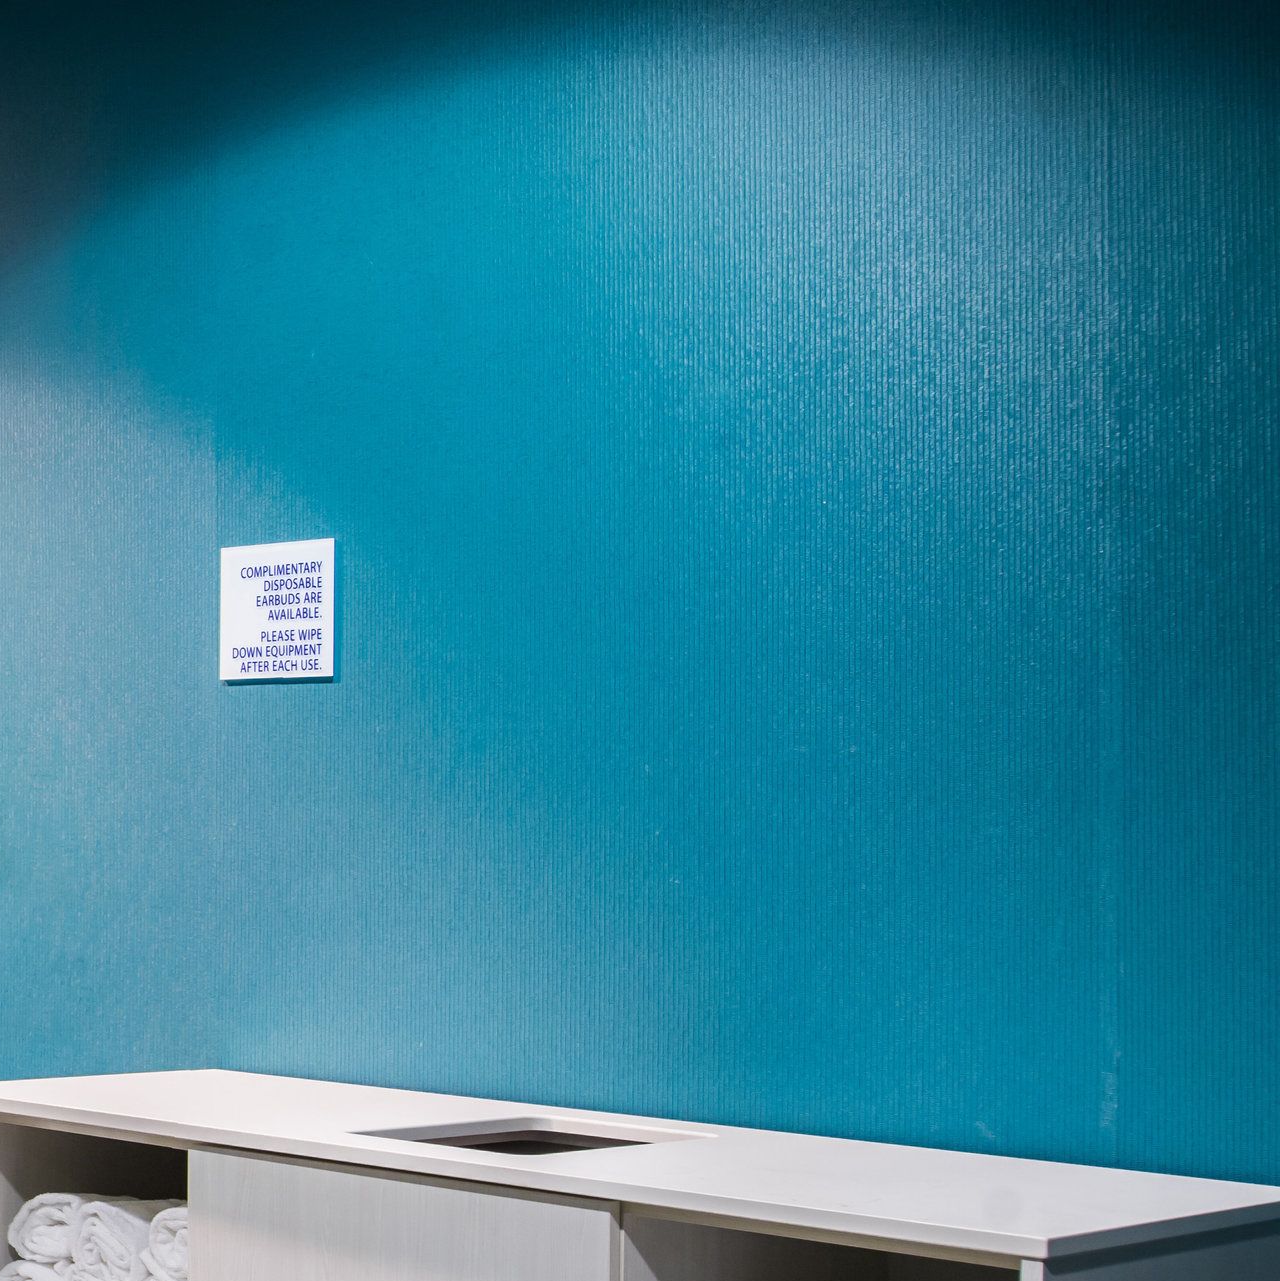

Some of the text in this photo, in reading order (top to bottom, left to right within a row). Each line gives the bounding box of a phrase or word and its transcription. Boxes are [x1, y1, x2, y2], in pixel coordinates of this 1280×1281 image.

[240, 561, 322, 579] COMPLIMENTARY
[264, 576, 322, 592] DISPOSABLE
[256, 592, 322, 607] EARBUDS ARE
[268, 607, 322, 621] AVAILABLE.
[260, 628, 322, 642] PLEASE WIPE
[232, 643, 322, 659] DOWN EQUIPMENT
[240, 659, 322, 673] AFTER EACH USE.
